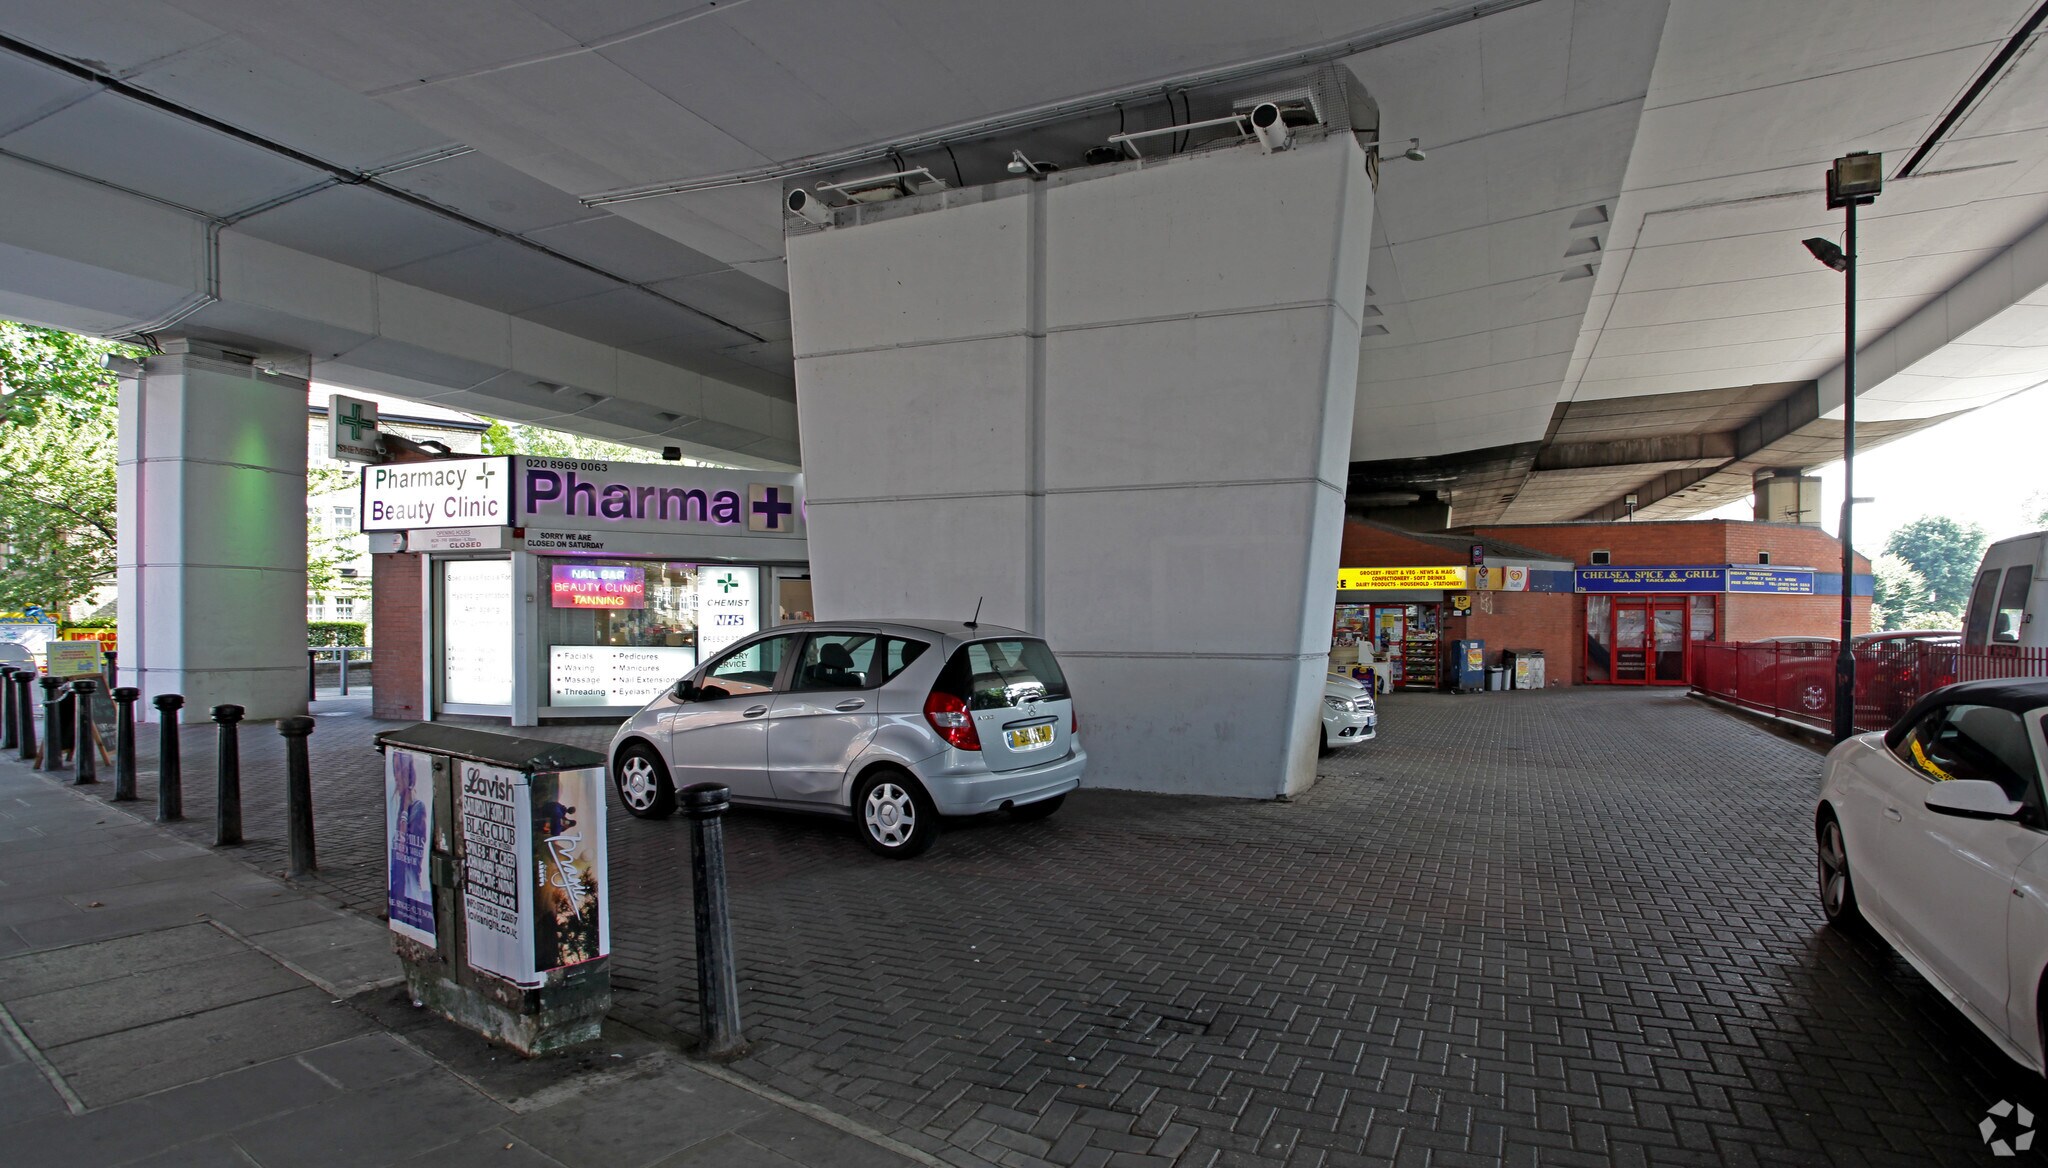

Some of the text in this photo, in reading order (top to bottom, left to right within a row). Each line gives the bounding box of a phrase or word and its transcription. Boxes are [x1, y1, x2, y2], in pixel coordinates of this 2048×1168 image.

[526, 459, 608, 472] 020 8969 0063
[376, 468, 467, 490] Pharmacy
[526, 469, 742, 524] Pharma
[372, 495, 498, 524] Beauty Clinic
[528, 540, 604, 550] CLOSED ON SATURDAY
[572, 569, 625, 580] NAIL BAR
[1582, 570, 1720, 579] CHELSEA SPICE & GRILL
[554, 582, 642, 593] BEAUTY CLINIC
[573, 595, 625, 606] TANNING
[714, 614, 744, 626] NHS
[71, 632, 117, 642] INDOO
[564, 652, 594, 660] Facials
[564, 665, 595, 673] Waxing
[565, 676, 600, 684] Massage
[565, 688, 606, 697] Threading
[620, 688, 650, 696] Eyelash
[464, 767, 515, 802] Lavish
[466, 816, 515, 846] BLAG CLUB
[500, 893, 516, 910] MOR
